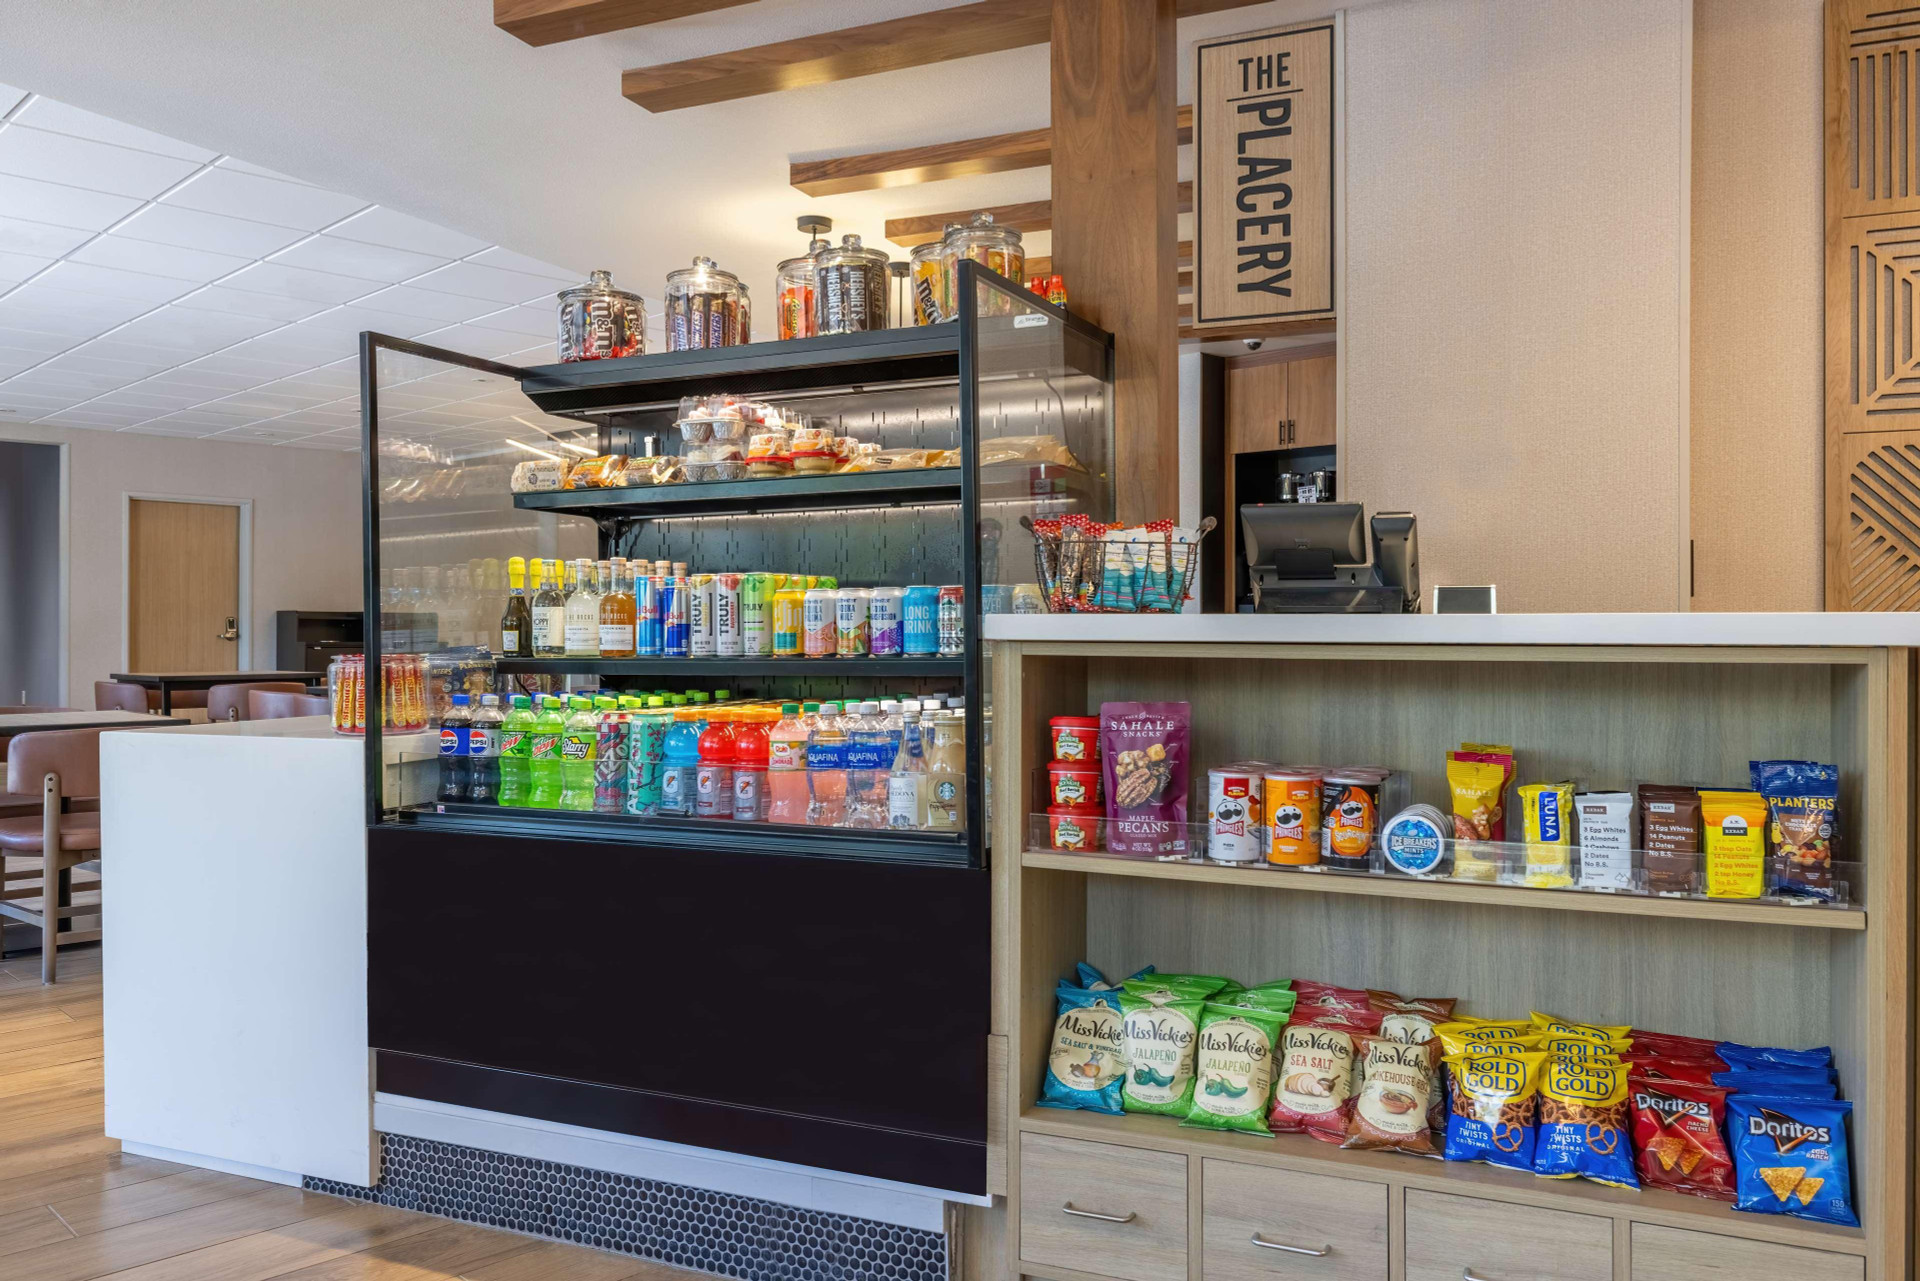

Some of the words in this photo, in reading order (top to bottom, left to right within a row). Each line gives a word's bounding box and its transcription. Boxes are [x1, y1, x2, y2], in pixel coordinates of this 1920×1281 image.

[1238, 52, 1291, 92] THE
[1236, 98, 1292, 297] PLACERY
[691, 594, 702, 637] TRULY
[718, 594, 729, 637] TRULY
[905, 605, 929, 619] LONG
[904, 620, 933, 633] DRINK
[1111, 721, 1174, 730] SAHALE
[440, 738, 457, 746] PEPSI
[470, 738, 487, 746] PEPSI
[663, 771, 678, 793] G
[698, 771, 712, 794] G
[736, 776, 753, 800] G
[1455, 787, 1494, 796] SAHALE
[1769, 797, 1835, 810] PLANTERS
[1340, 816, 1363, 828] PRINGLES
[1544, 797, 1557, 838] LUNA
[1118, 821, 1170, 833] PECANS
[1216, 822, 1244, 836] PRINGLES
[1274, 825, 1303, 840] PRINGLES
[1391, 835, 1403, 847] ICE
[1403, 836, 1437, 849] BREAKERS
[1059, 1015, 1092, 1037] Miss
[1124, 1020, 1151, 1039] Miss
[1149, 1019, 1194, 1048] Vickie's
[1061, 1036, 1072, 1047] SEA
[1073, 1041, 1088, 1049] SALT
[1200, 1033, 1227, 1051] Miss
[1225, 1032, 1267, 1061] Vickie's
[1132, 1047, 1177, 1061] JALAPEÑO
[1206, 1058, 1251, 1073] JALAPEÑO
[1290, 1055, 1307, 1067] SEA
[1311, 1056, 1333, 1070] SALT
[1468, 1061, 1520, 1075] ROLD
[1558, 1063, 1609, 1079] ROLD
[1466, 1073, 1519, 1092] GOLD
[1555, 1078, 1609, 1096] GOLD
[1635, 1092, 1710, 1115] Doritos
[1465, 1121, 1481, 1131] TINY
[1555, 1125, 1574, 1134] TINY
[1687, 1120, 1709, 1128] NACHO
[1750, 1116, 1830, 1142] Doritos
[1459, 1128, 1488, 1140] TWISTS
[1550, 1133, 1582, 1143] TWISTS
[1456, 1137, 1491, 1149] ORIGINAL
[1547, 1144, 1585, 1152] ORIGINAL
[1806, 1152, 1829, 1160] RANCH
[1832, 1199, 1845, 1208] 150
